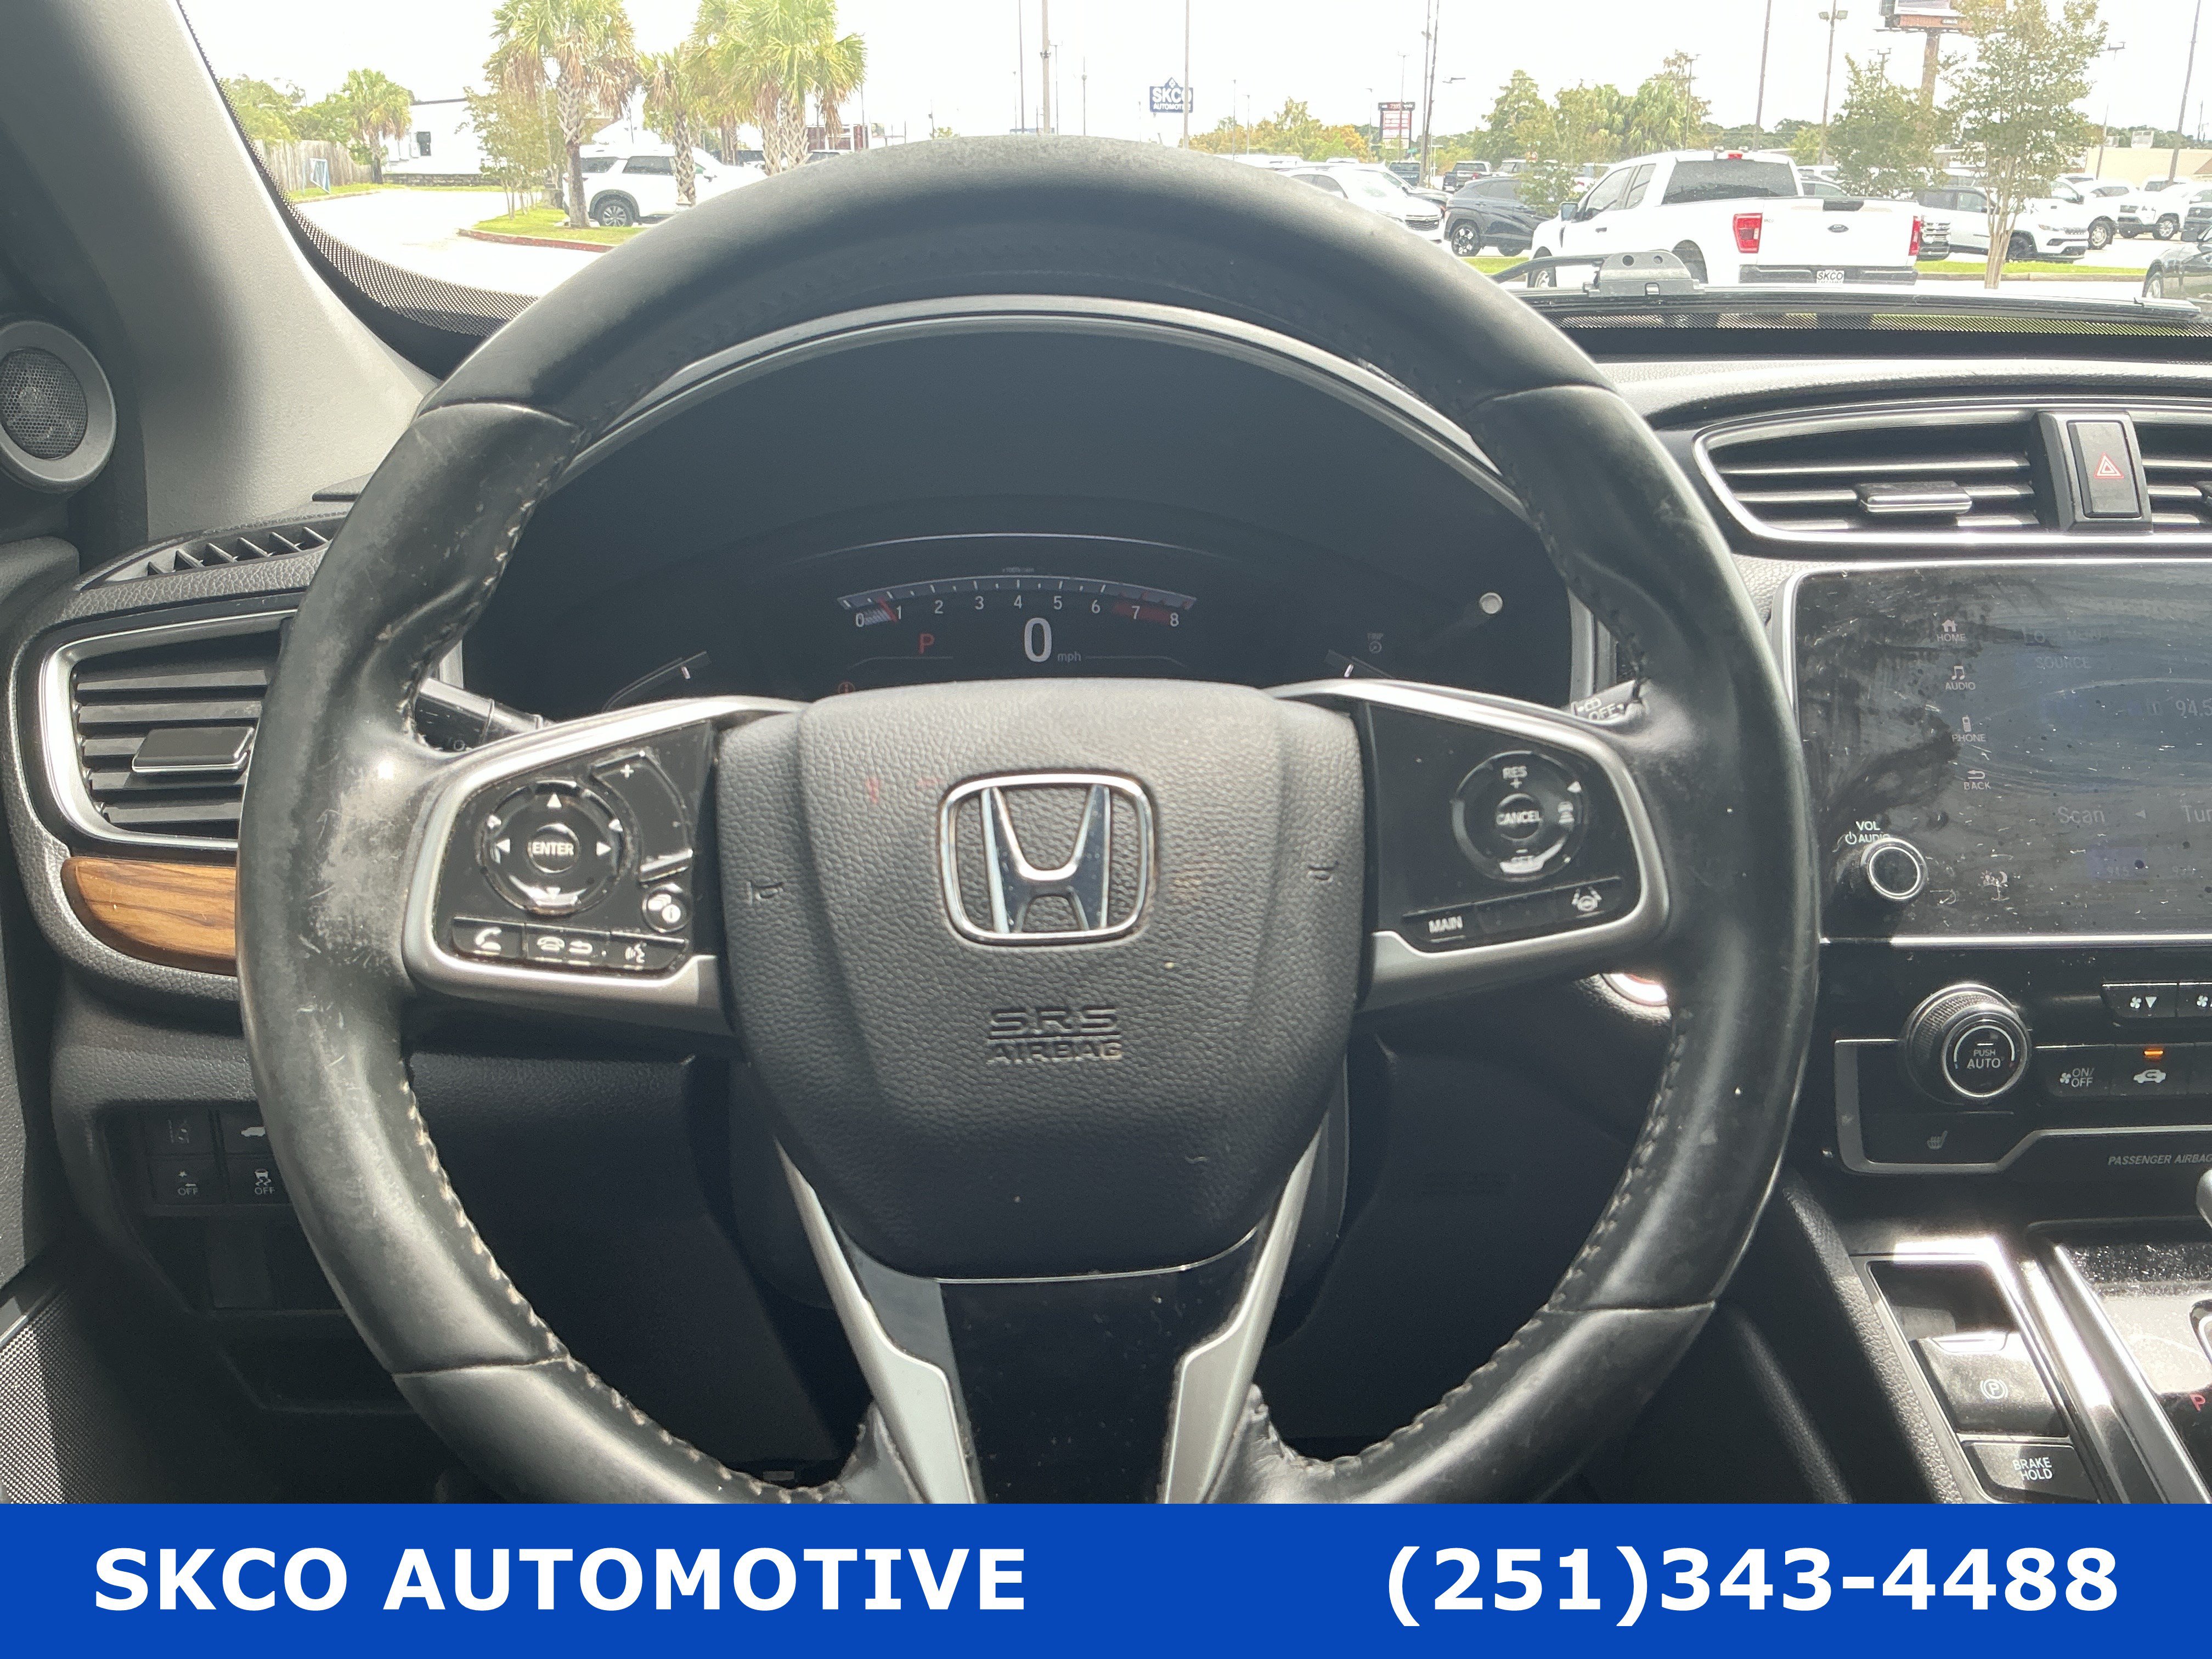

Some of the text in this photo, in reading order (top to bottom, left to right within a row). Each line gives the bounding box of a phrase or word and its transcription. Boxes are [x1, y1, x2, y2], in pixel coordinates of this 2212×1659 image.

[1152, 87, 1192, 103] SKCO
[1817, 272, 1843, 281] SKCO
[855, 594, 1180, 628] 0 1 2 3 4 5 6 7 8
[918, 617, 1081, 663] P 0 mph
[1937, 633, 1966, 642] HOME
[1945, 681, 1976, 691] AUDIO
[1951, 733, 1987, 743] PHONE
[1963, 781, 1991, 791] BACK
[1496, 810, 1544, 825] CANCEL
[2057, 805, 2106, 823] Scan
[1855, 821, 1881, 831] VOL
[532, 841, 574, 856] ENTER
[1428, 915, 1463, 933] MAIN
[988, 1006, 1121, 1039] SRS
[1967, 1058, 2001, 1069] AUTO
[2071, 1077, 2093, 1088] OFF
[2108, 1155, 2171, 1165] PASSENGER
[178, 1187, 198, 1196] OFF
[254, 1187, 275, 1195] OFF
[2190, 1393, 2206, 1412] P
[2012, 1457, 2052, 1471] BRAKE
[2021, 1468, 2053, 1481] HOLD
